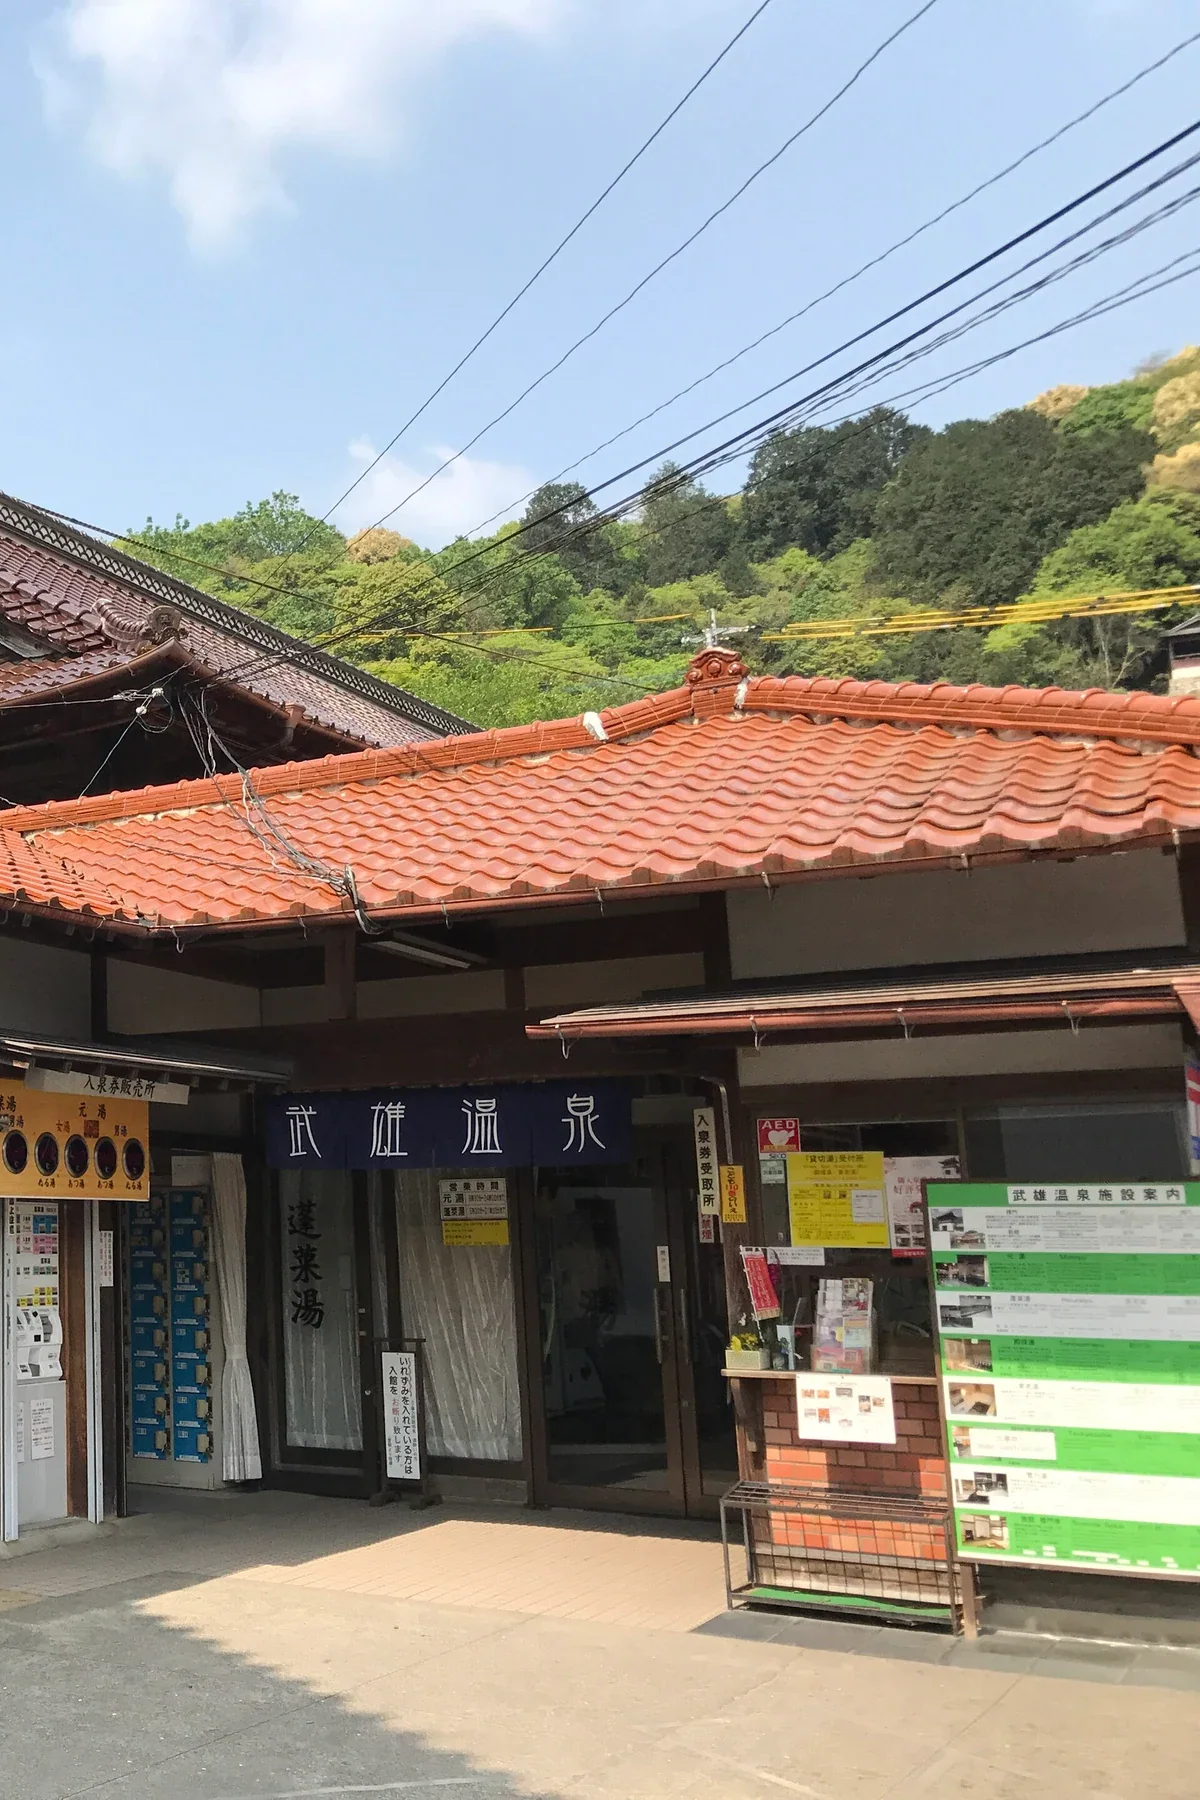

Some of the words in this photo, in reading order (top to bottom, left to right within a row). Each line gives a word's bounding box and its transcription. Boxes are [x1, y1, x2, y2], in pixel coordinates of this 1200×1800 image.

[83, 1075, 156, 1099] 入泉券販売所
[285, 1093, 607, 1158] 武雄温泉
[762, 1120, 796, 1130] AED
[697, 1114, 715, 1207] 入泉券受取所
[1013, 1188, 1180, 1202] 武雄温泉施設案内
[400, 1357, 413, 1475] いれずみを入れている方は
